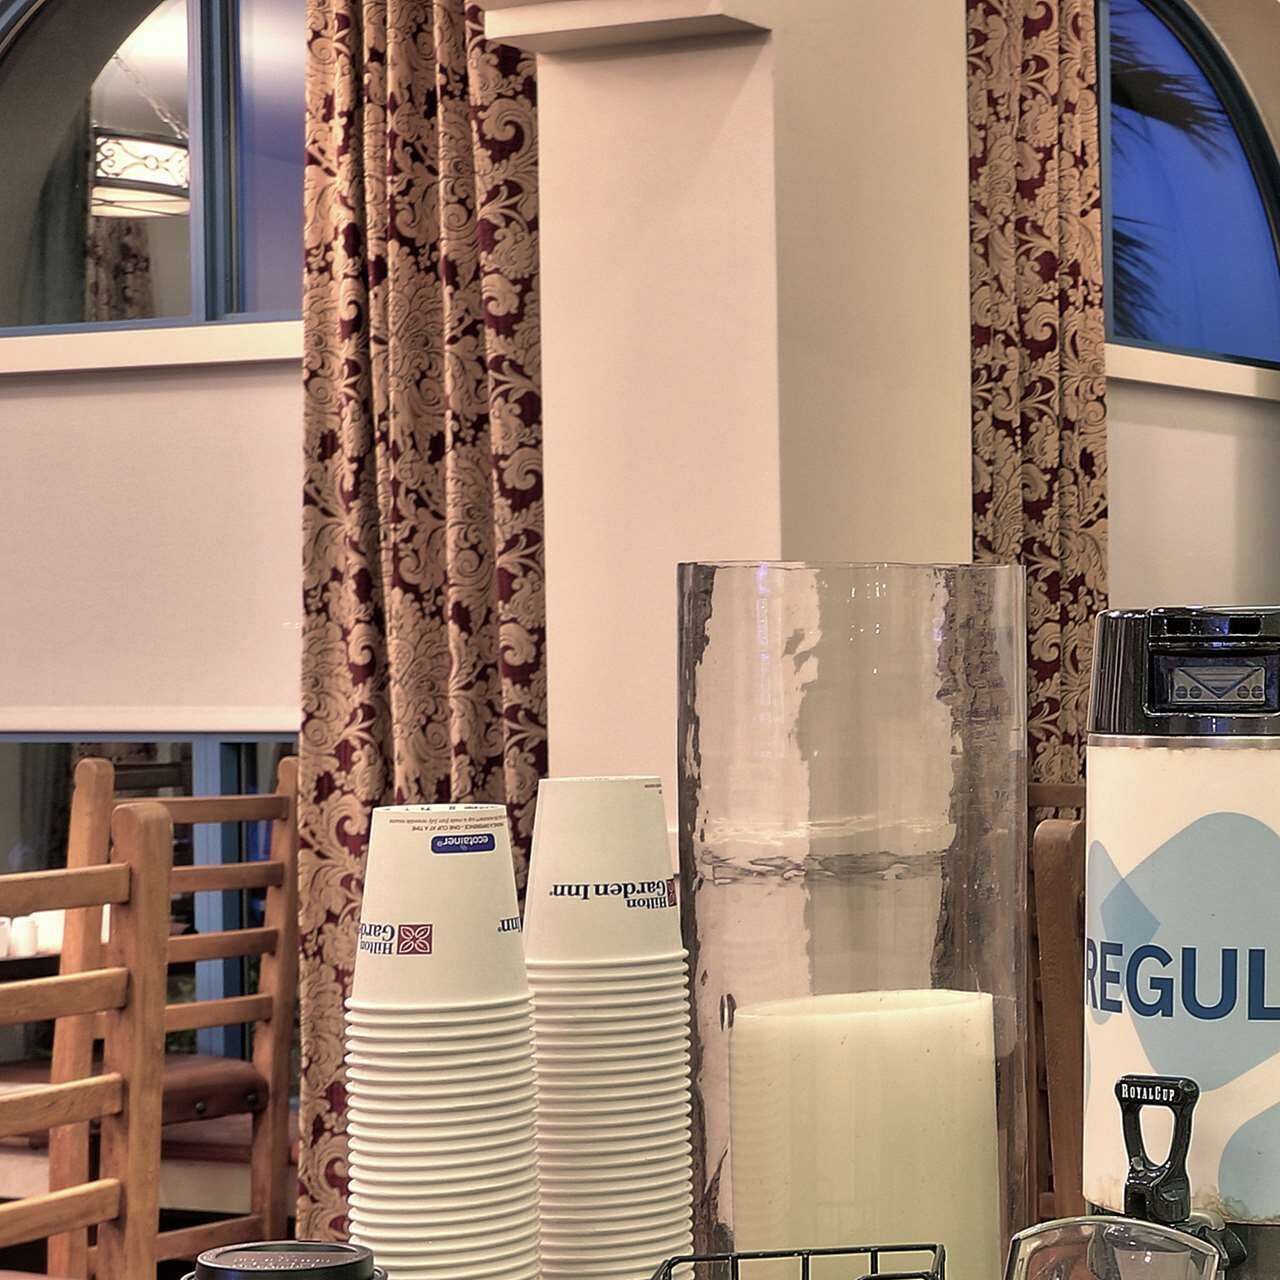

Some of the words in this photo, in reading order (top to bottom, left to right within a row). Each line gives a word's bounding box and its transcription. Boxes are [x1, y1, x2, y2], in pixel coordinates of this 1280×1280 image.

[550, 884, 589, 900] Inn
[594, 881, 665, 898] Garden
[626, 897, 666, 909] Hilton
